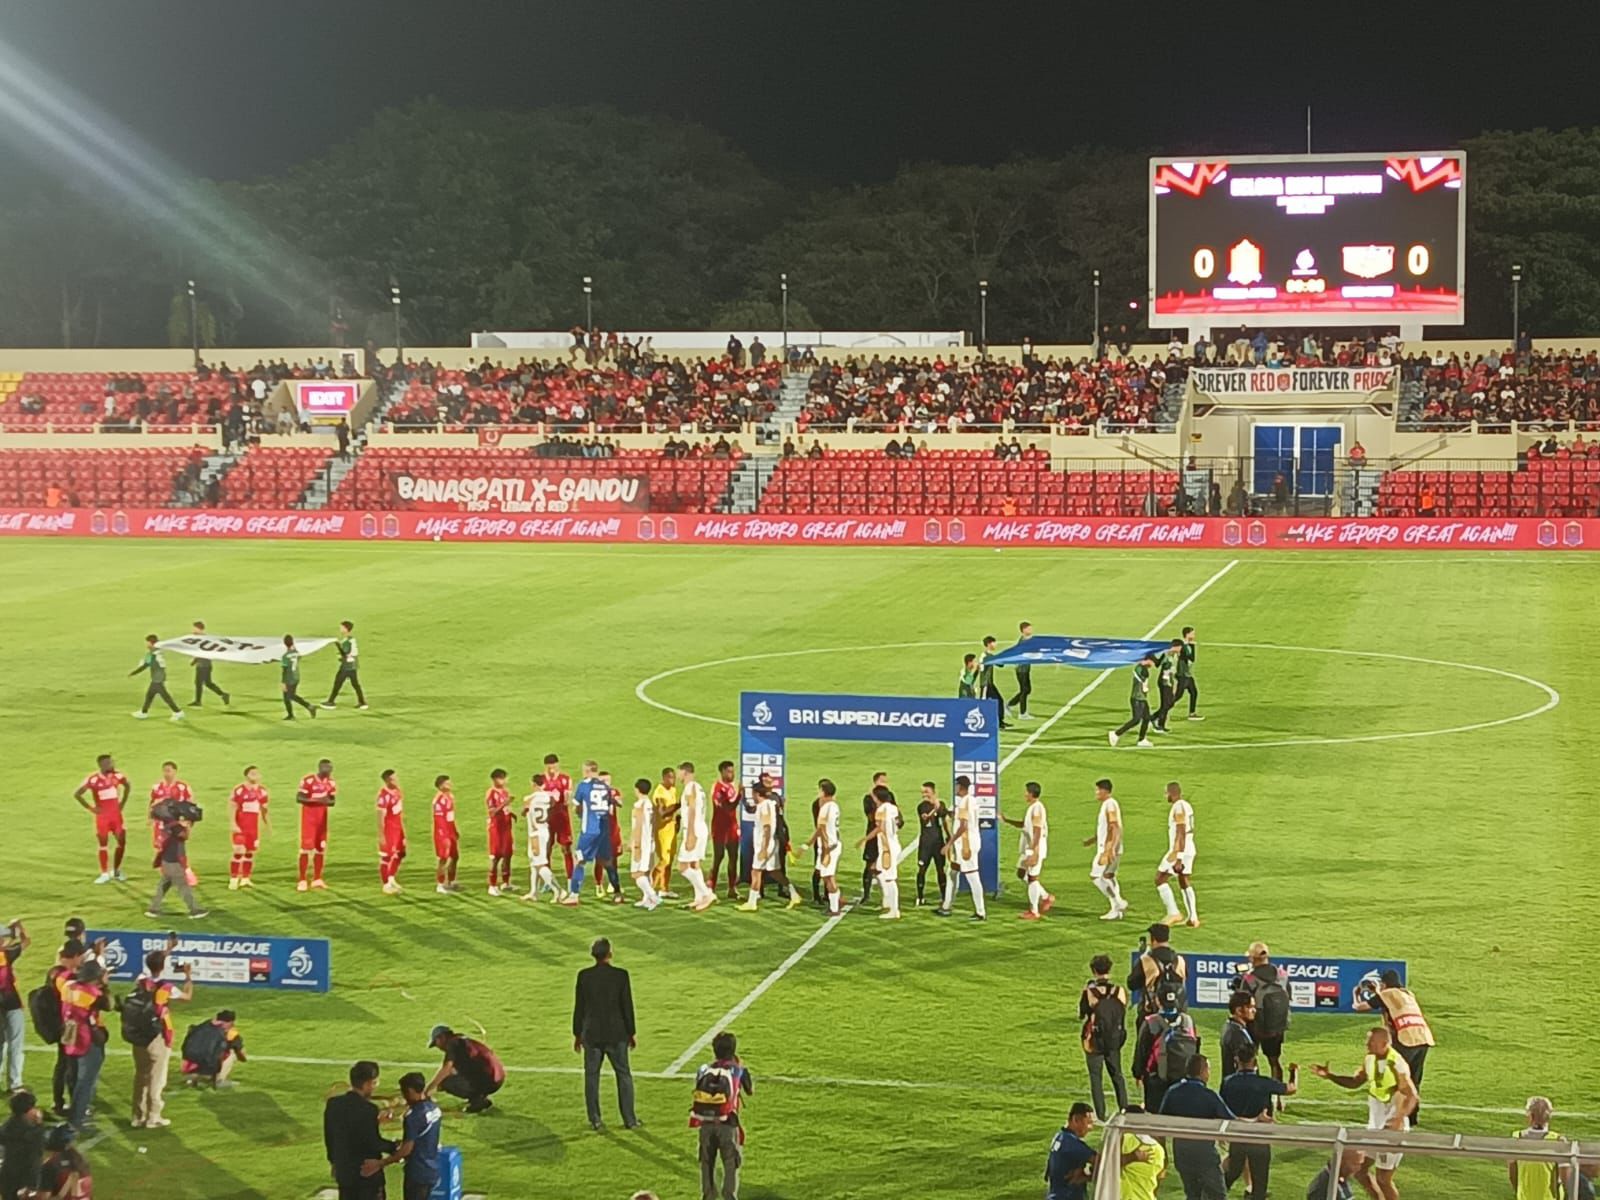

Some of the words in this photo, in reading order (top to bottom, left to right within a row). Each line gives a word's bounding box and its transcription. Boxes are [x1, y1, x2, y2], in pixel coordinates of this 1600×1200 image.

[1194, 249, 1214, 278] 0
[1408, 245, 1429, 275] 0
[1193, 371, 1246, 393] OREVER
[1251, 372, 1275, 392] RED
[1292, 371, 1349, 391] FOREVER
[398, 476, 525, 502] BANASPATI
[531, 477, 639, 502] X-GANDU
[144, 514, 190, 532] MAKE
[246, 515, 298, 533] GREAT
[415, 517, 460, 536] MAKE
[520, 518, 573, 536] GREAT
[694, 519, 742, 538] MAKE
[802, 519, 857, 539] GREAT
[983, 521, 1032, 541] MAKE
[1095, 522, 1153, 542] GREAT
[1403, 522, 1464, 543] GREAT
[788, 709, 819, 725] BRI
[1196, 960, 1224, 974] BRI
